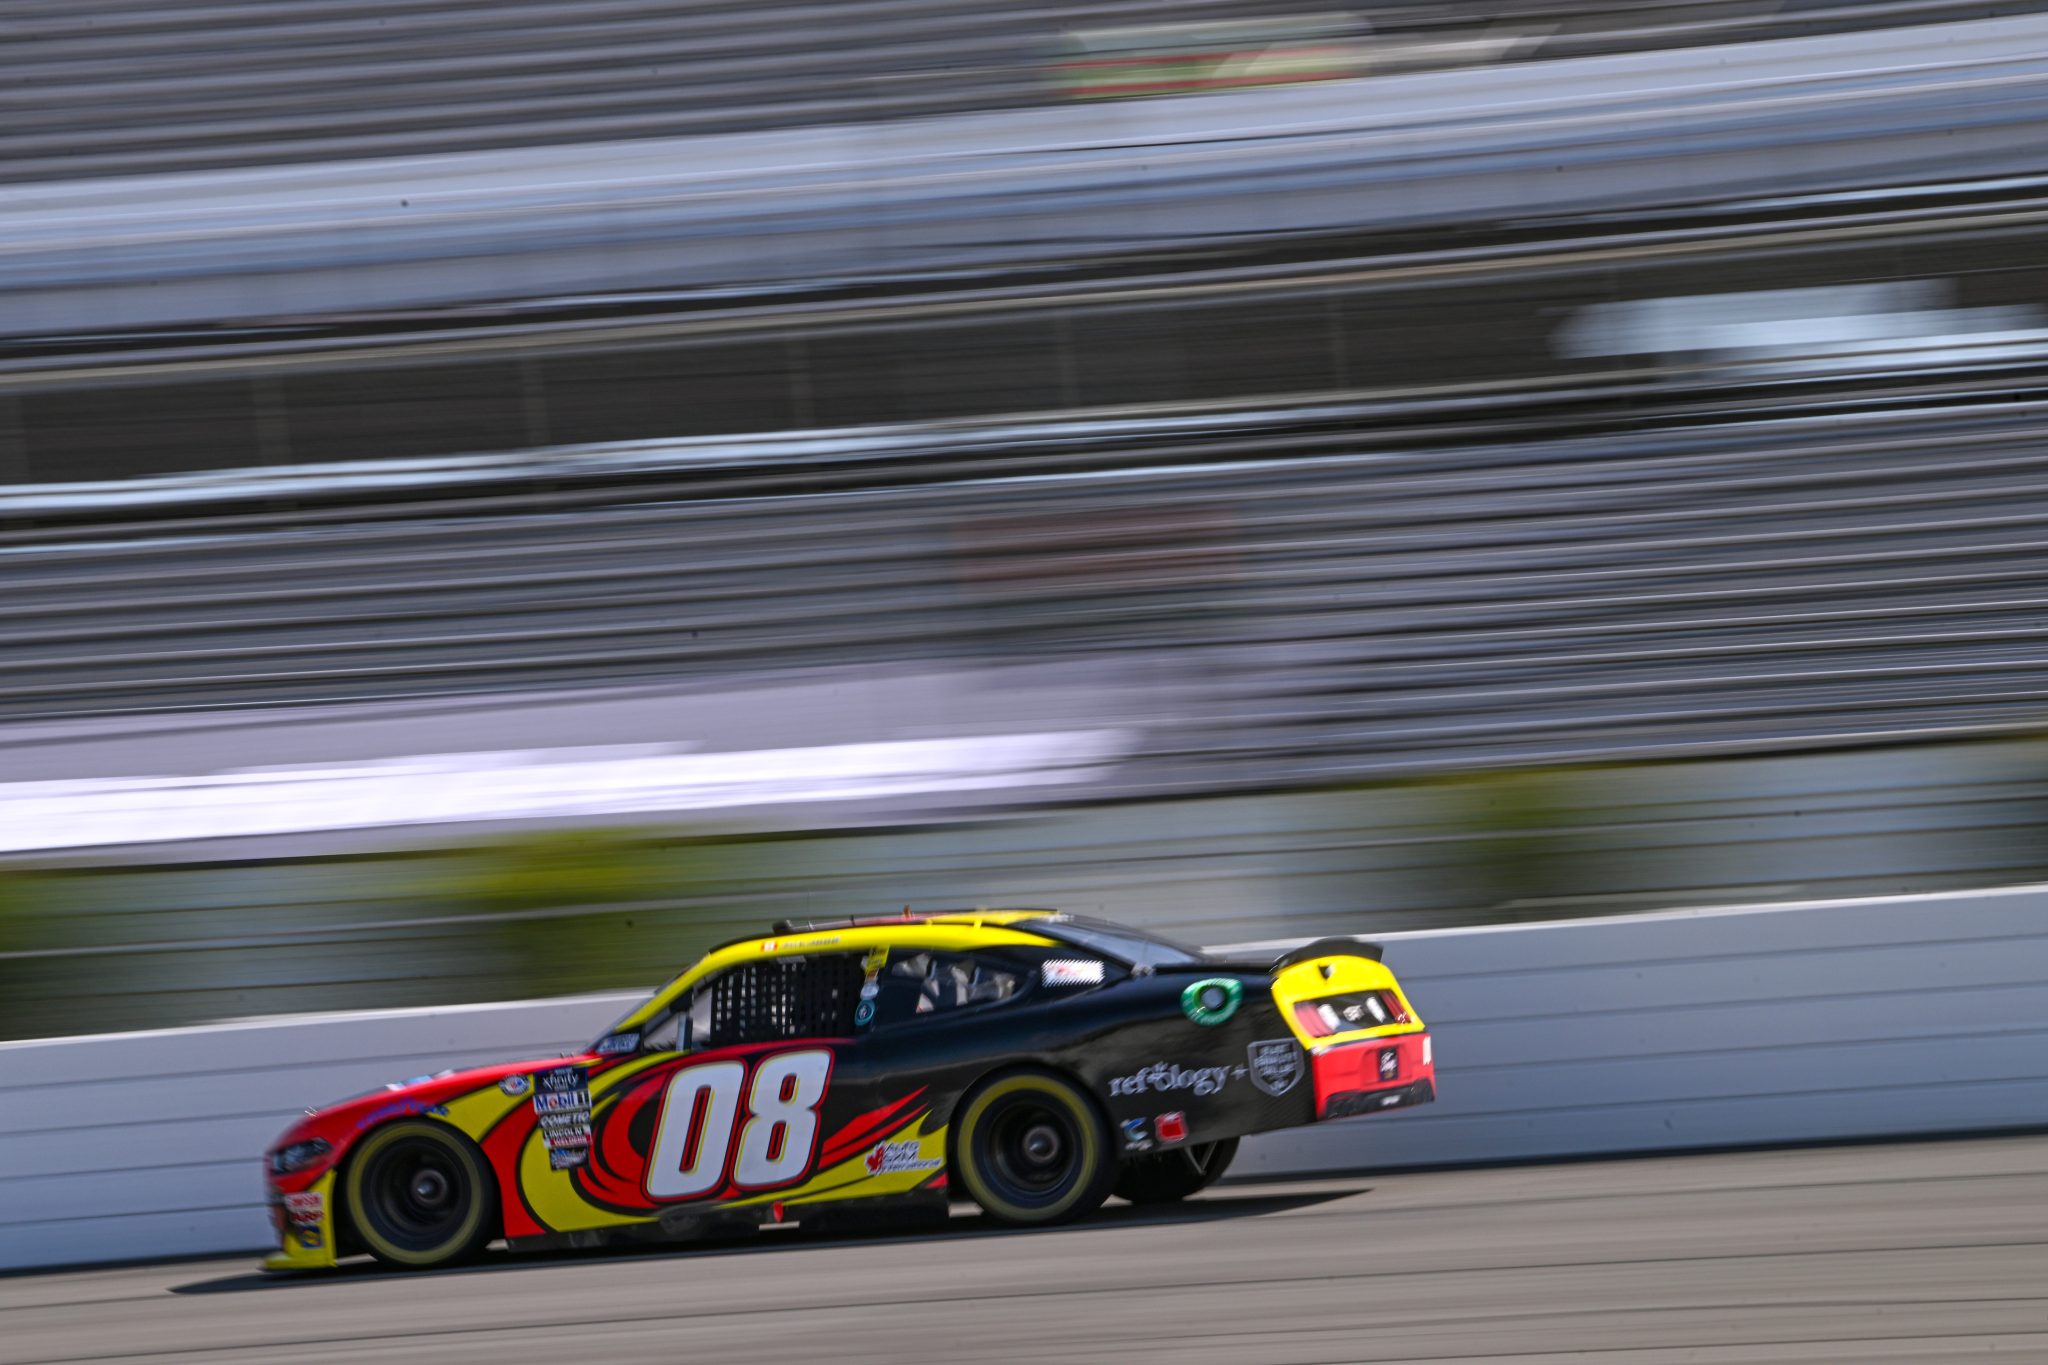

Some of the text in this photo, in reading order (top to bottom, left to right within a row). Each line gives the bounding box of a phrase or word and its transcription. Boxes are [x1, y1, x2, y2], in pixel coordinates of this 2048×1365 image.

[536, 1092, 575, 1111] Mobil
[542, 1112, 589, 1127] COMETIC
[643, 1048, 832, 1200] 08
[544, 1127, 582, 1138] LINCOLN
